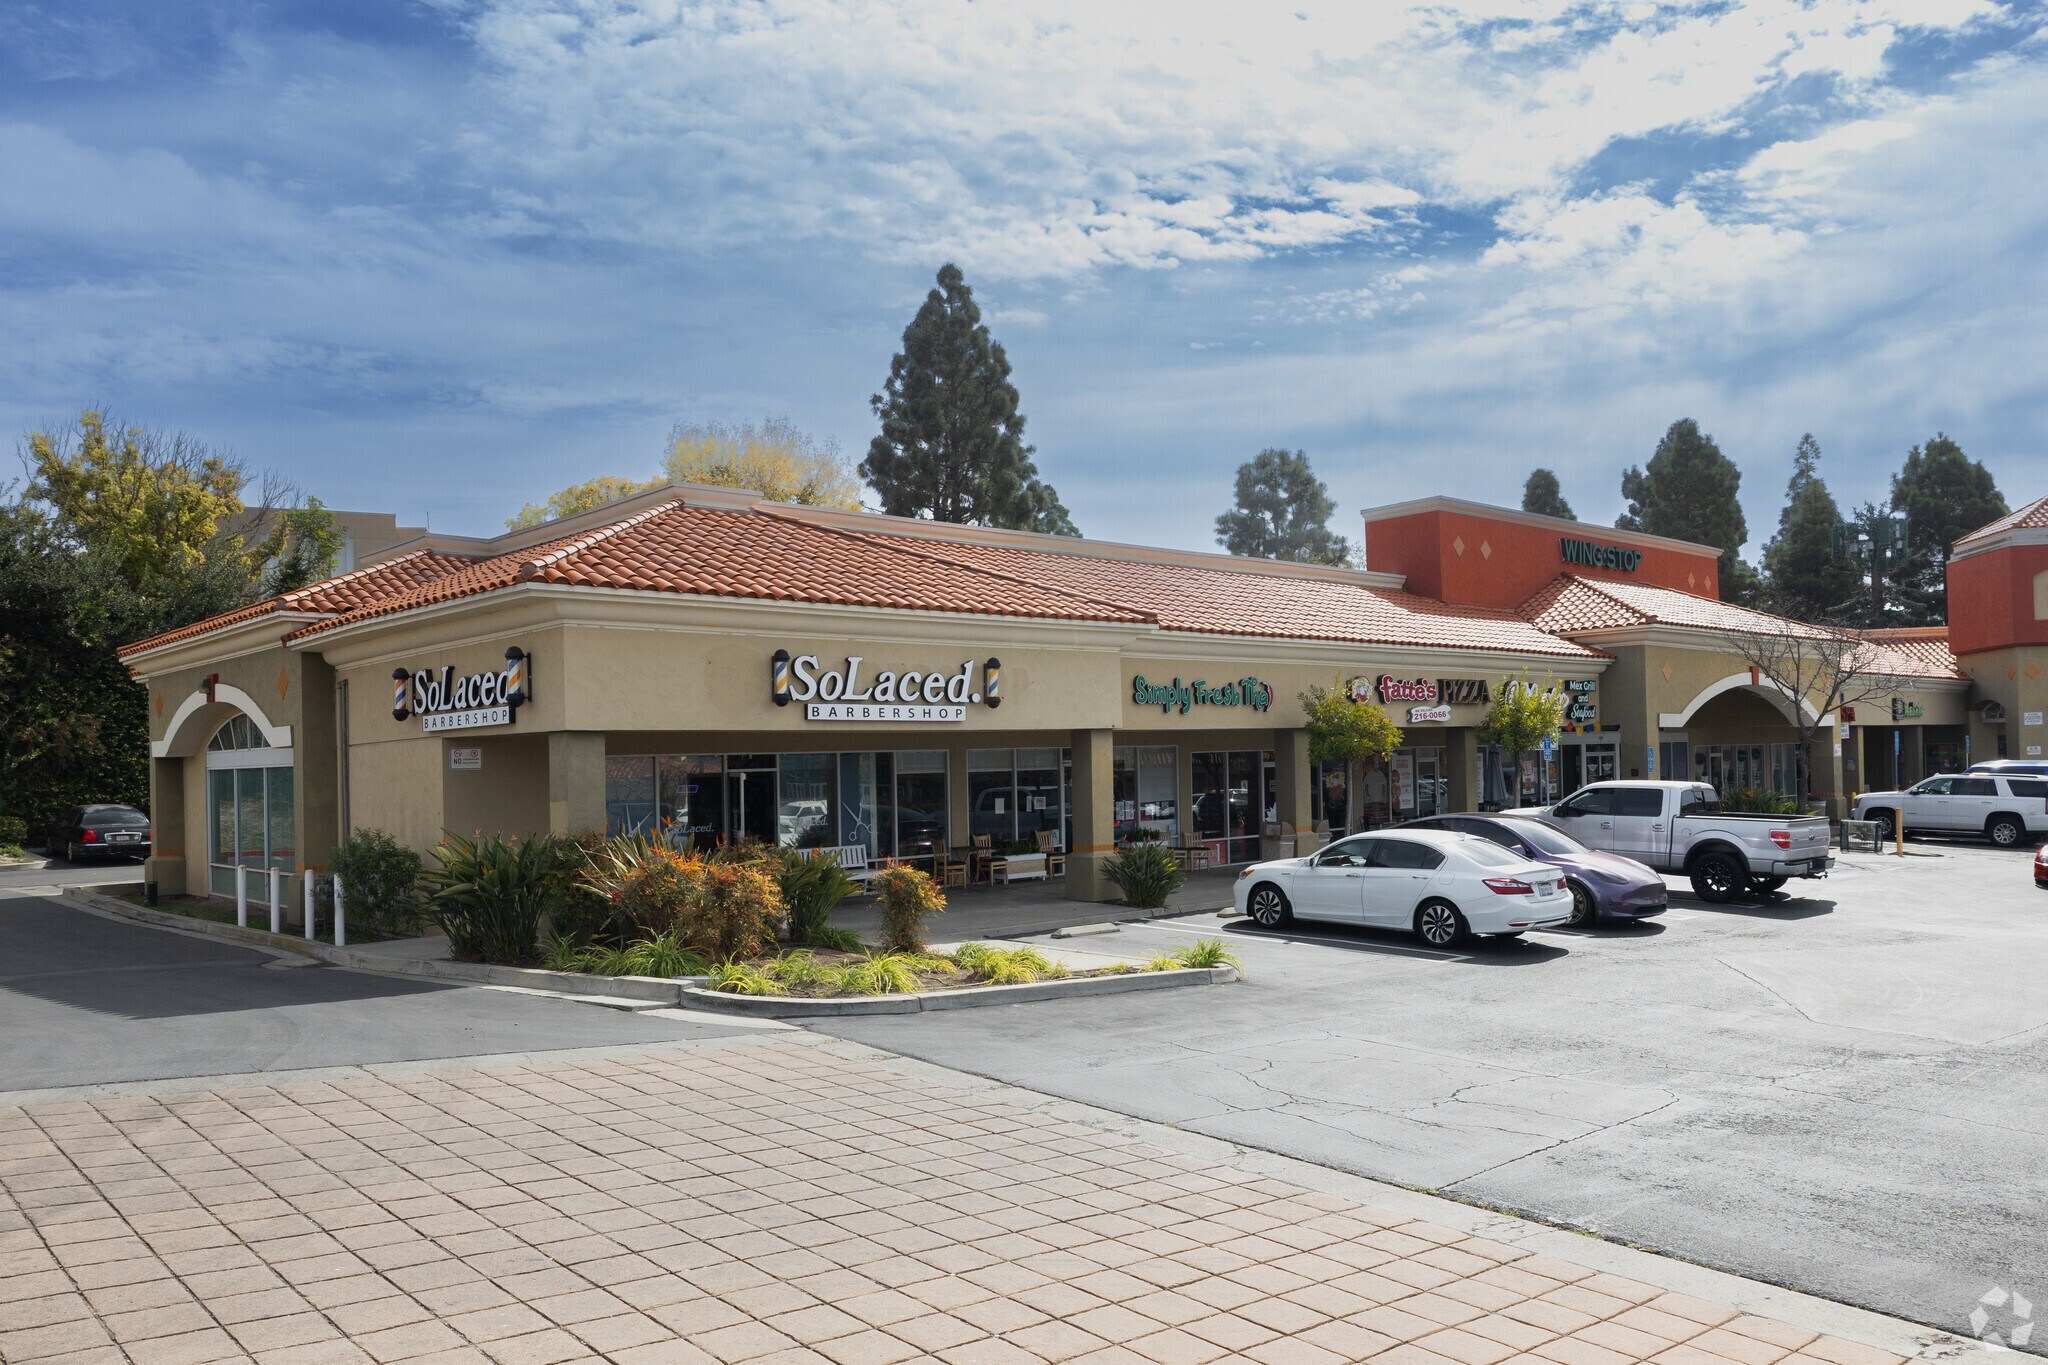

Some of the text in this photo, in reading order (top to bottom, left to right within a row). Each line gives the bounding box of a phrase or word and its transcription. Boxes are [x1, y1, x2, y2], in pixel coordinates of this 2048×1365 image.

[788, 655, 982, 703] SoLaced.
[1569, 680, 1596, 691] Mex Grill
[1135, 674, 1192, 714] Simply
[1194, 680, 1240, 706] Fresh
[1379, 674, 1437, 704] fatte's
[1440, 679, 1491, 704] PIZZA
[1577, 693, 1589, 703] and
[424, 709, 508, 729] BARBERSHOP
[811, 706, 963, 719] BARBERSHOP
[1414, 710, 1447, 720] 216-0066
[1570, 703, 1596, 722] Seafood
[453, 757, 462, 765] NO
[671, 822, 715, 834] oLaced.
